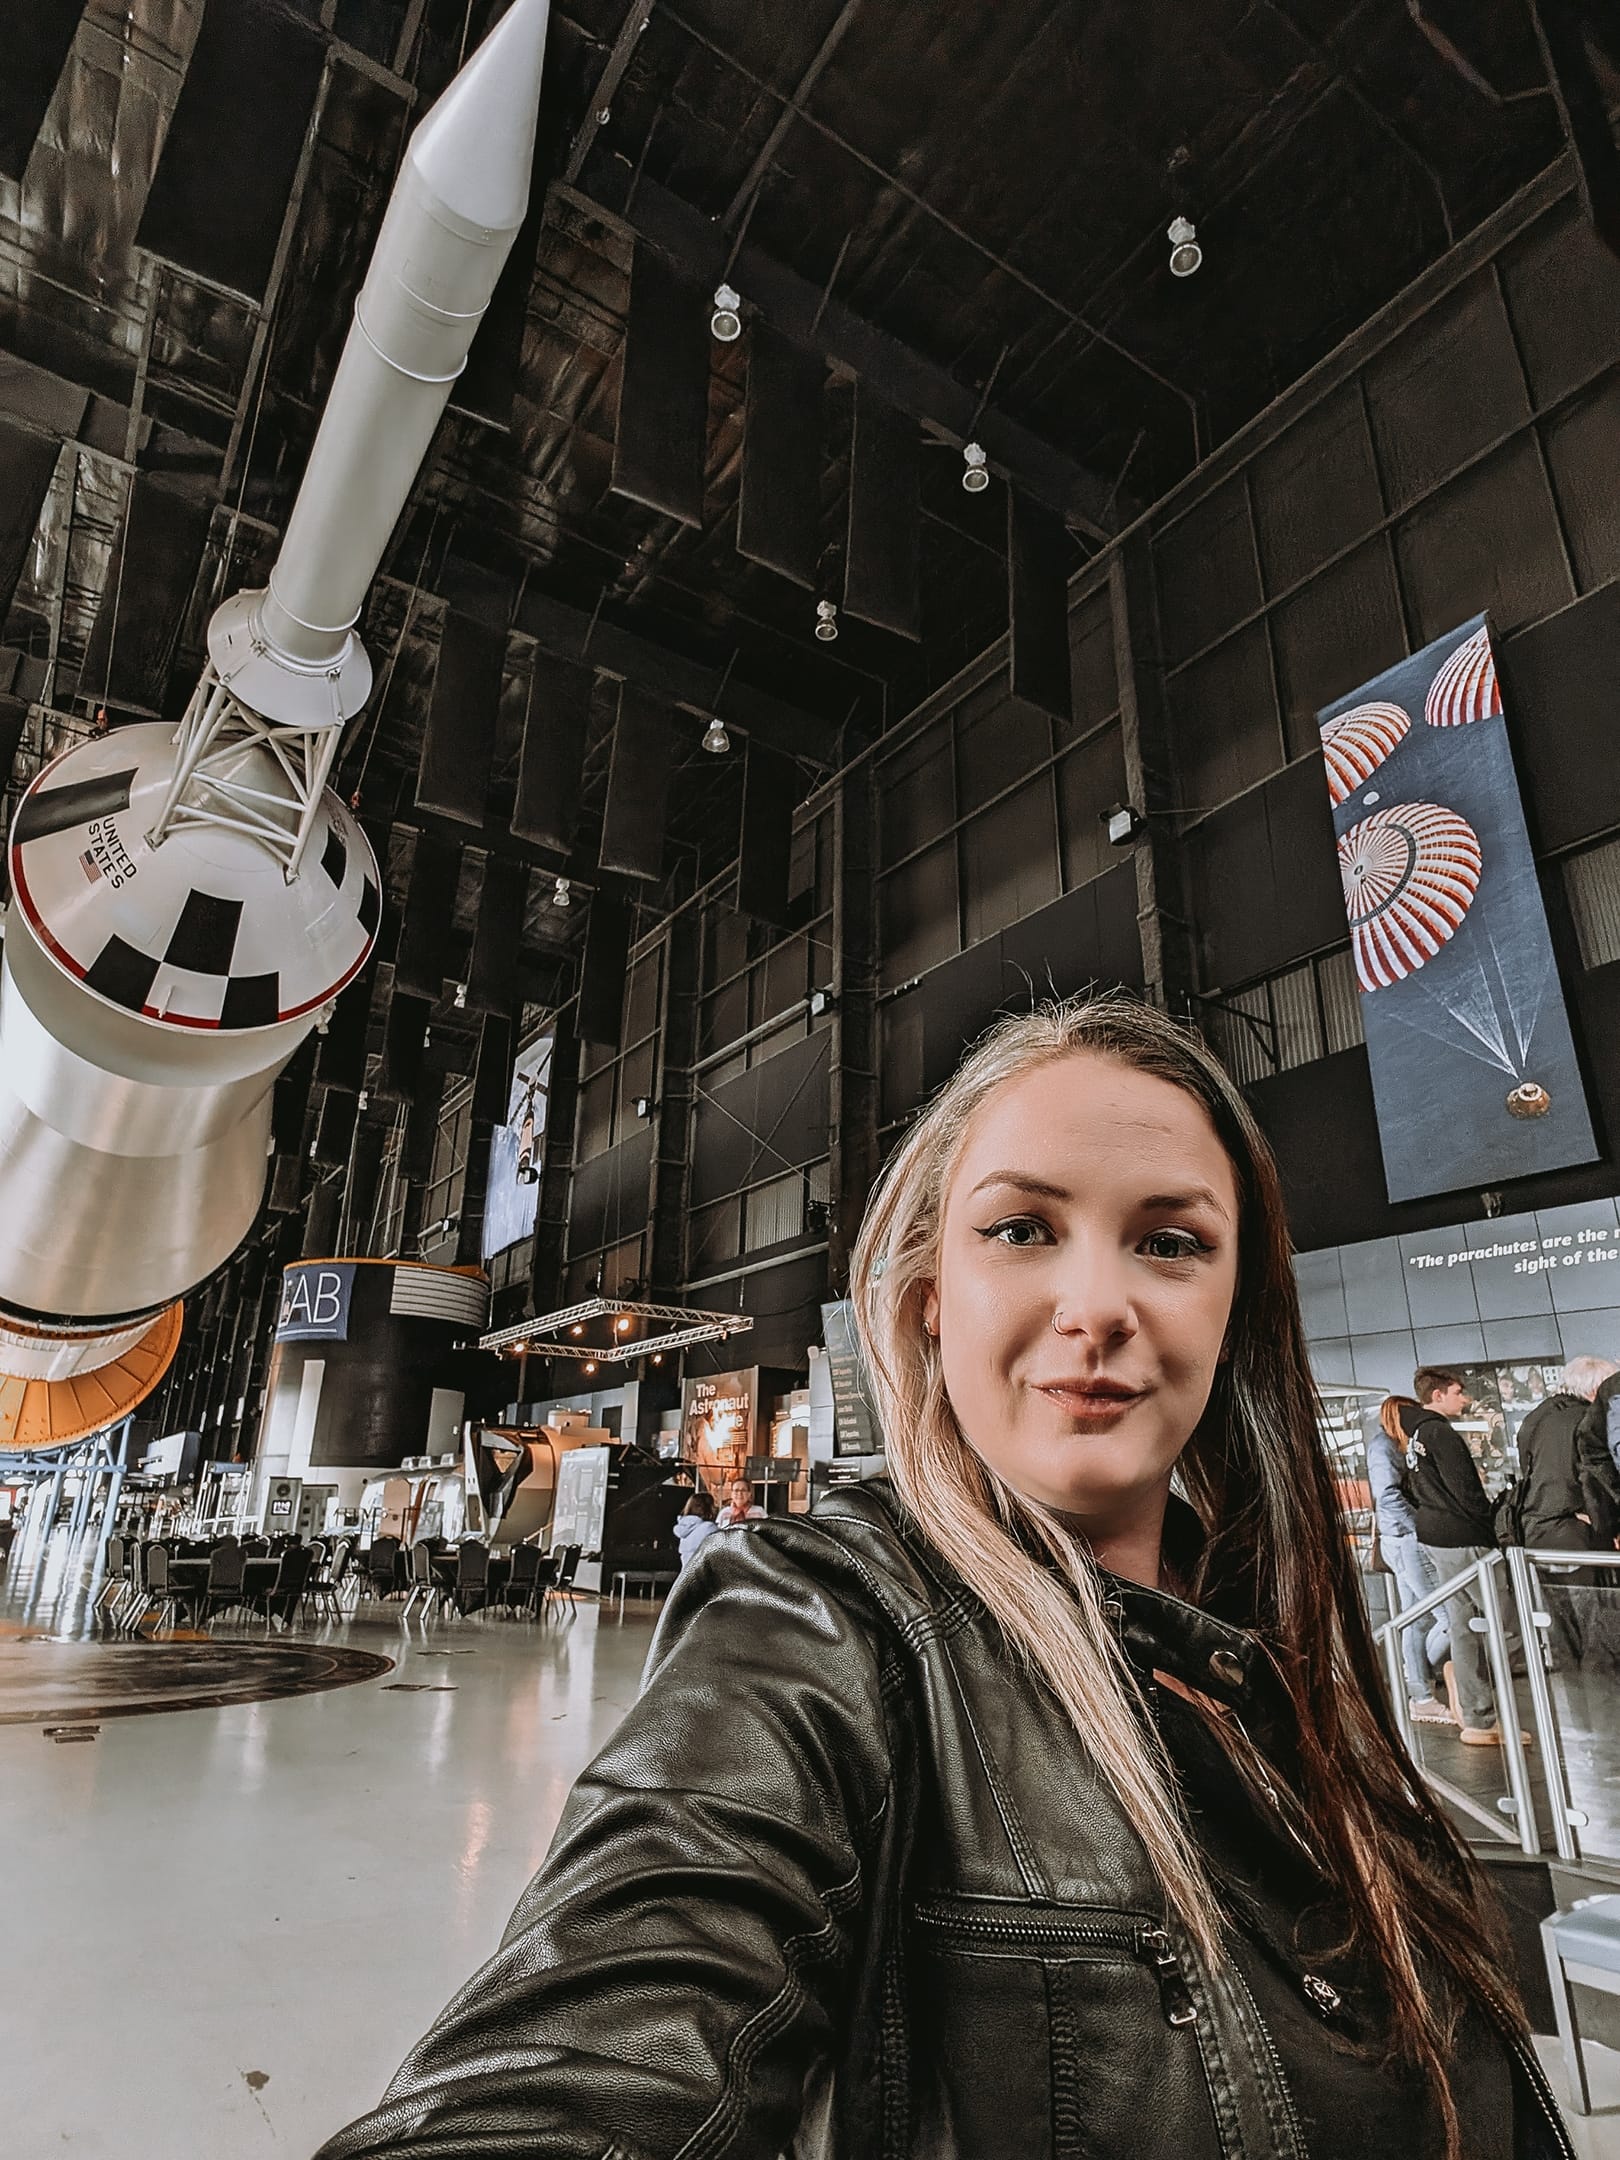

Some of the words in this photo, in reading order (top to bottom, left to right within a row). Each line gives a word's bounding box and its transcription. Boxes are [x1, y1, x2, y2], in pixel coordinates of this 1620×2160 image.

[89, 823, 124, 889] STATES
[103, 816, 137, 878] UNITED
[1447, 1241, 1537, 1267] parachutes
[1542, 1235, 1573, 1249] are
[1577, 1228, 1608, 1243] the
[1514, 1255, 1558, 1275] sight
[1562, 1250, 1583, 1266] of
[1587, 1247, 1618, 1263] the
[689, 1392, 749, 1416] Astronaut
[695, 1383, 717, 1398] The
